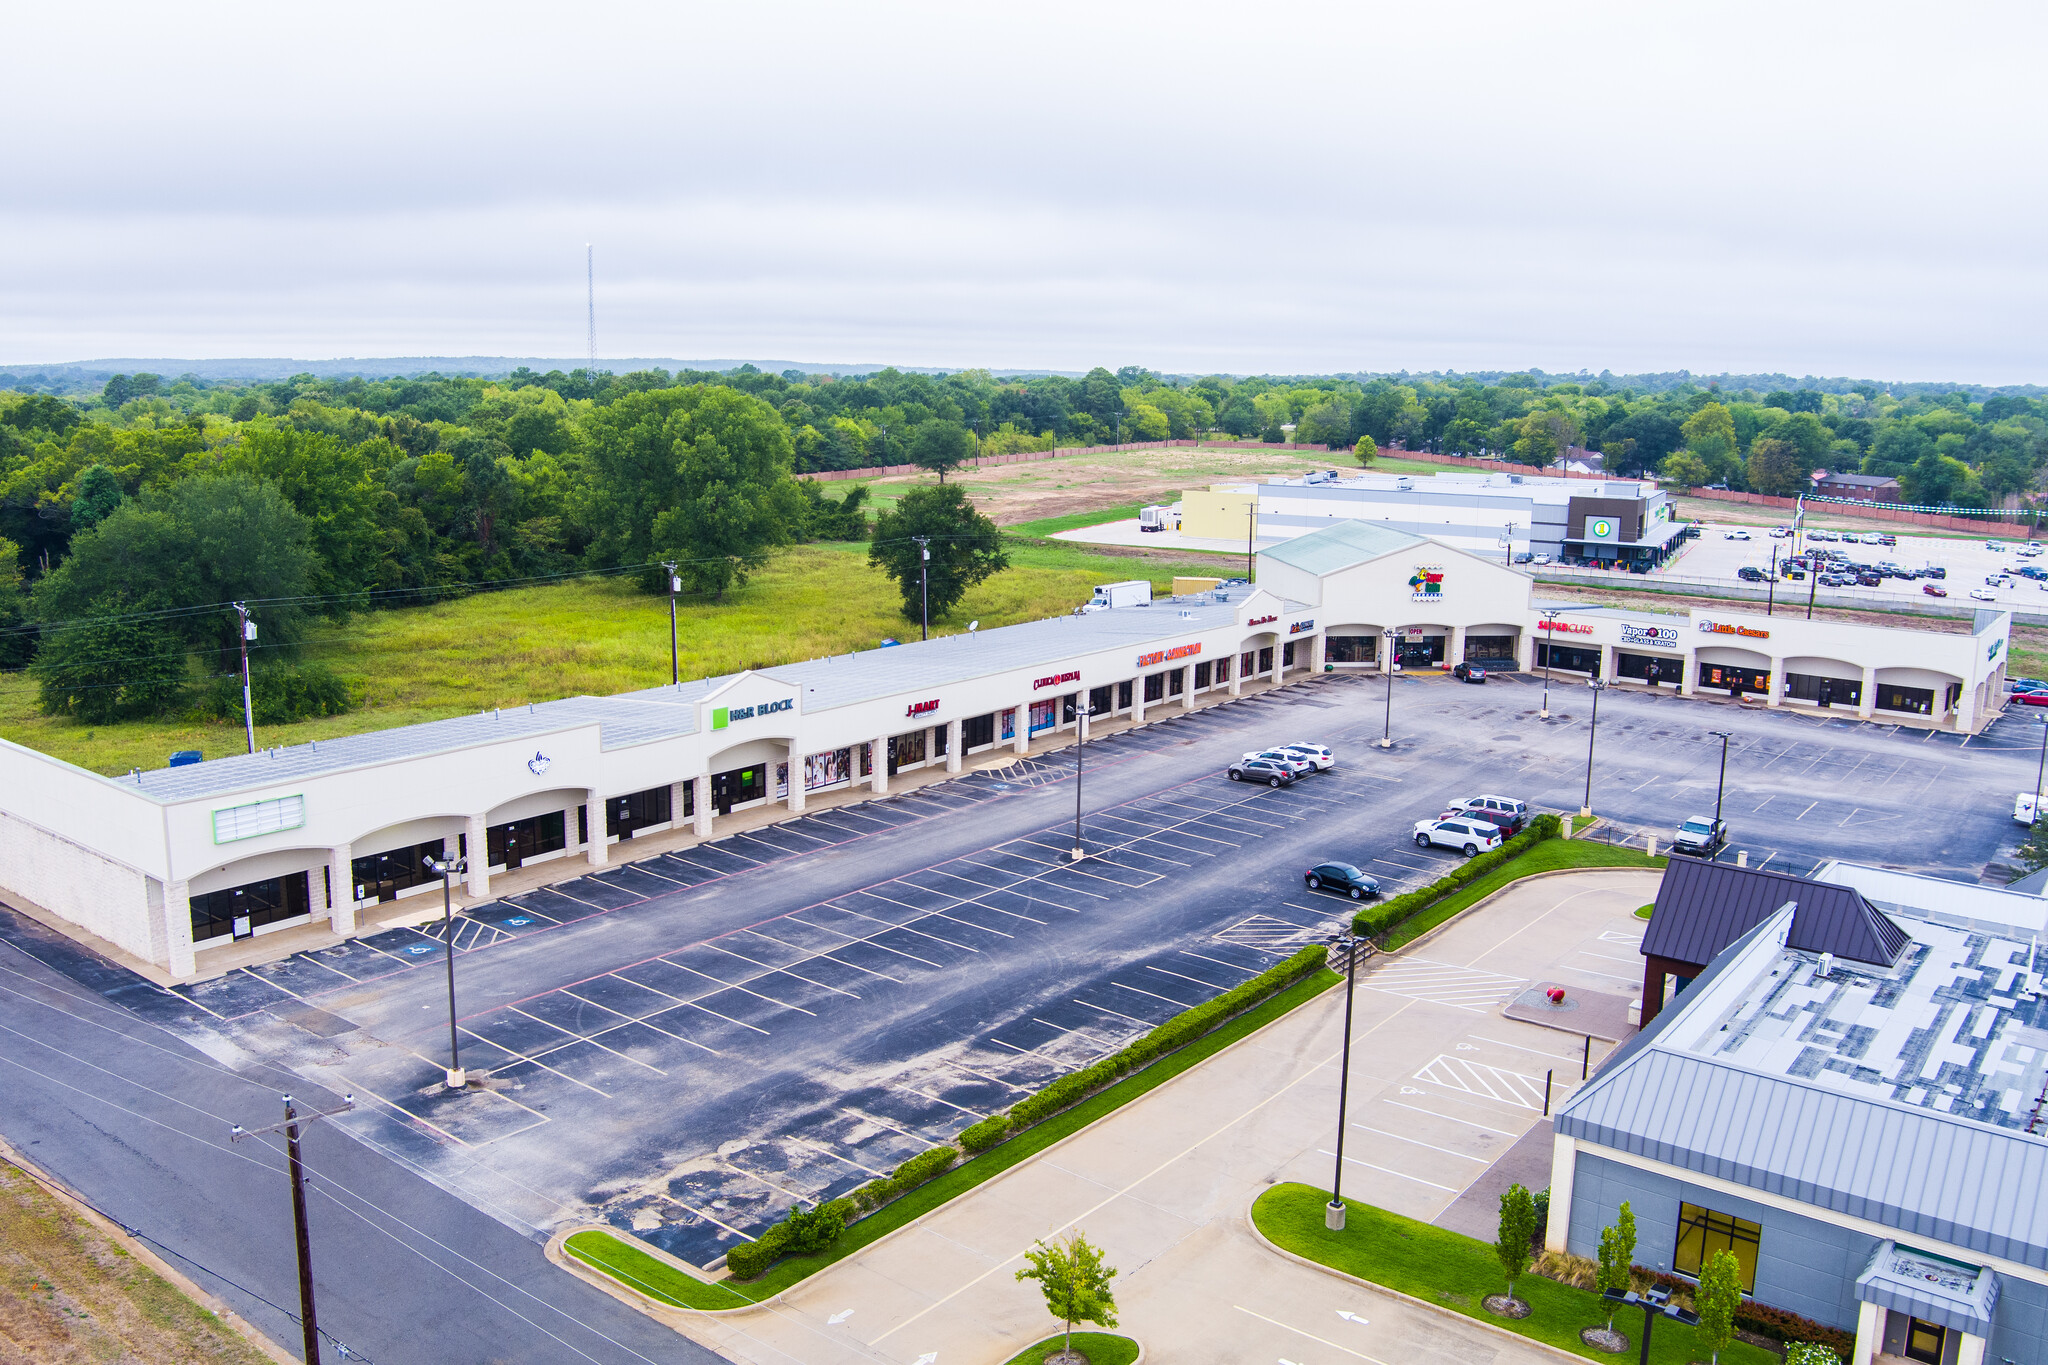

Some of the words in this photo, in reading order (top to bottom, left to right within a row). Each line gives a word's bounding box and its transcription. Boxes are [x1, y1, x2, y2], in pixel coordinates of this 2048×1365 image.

[1598, 523, 1605, 534] 1
[1537, 620, 1594, 634] SUPERCUTS
[1621, 624, 1648, 637] Vapor
[1657, 628, 1677, 640] 100
[1712, 622, 1735, 634] Little
[1736, 625, 1769, 638] Caesars
[1137, 651, 1165, 667] FACTORY
[1165, 642, 1201, 660] CONNECTION
[730, 706, 754, 722] H&R
[757, 698, 793, 716] BLOCK
[905, 699, 940, 717] J-MART
